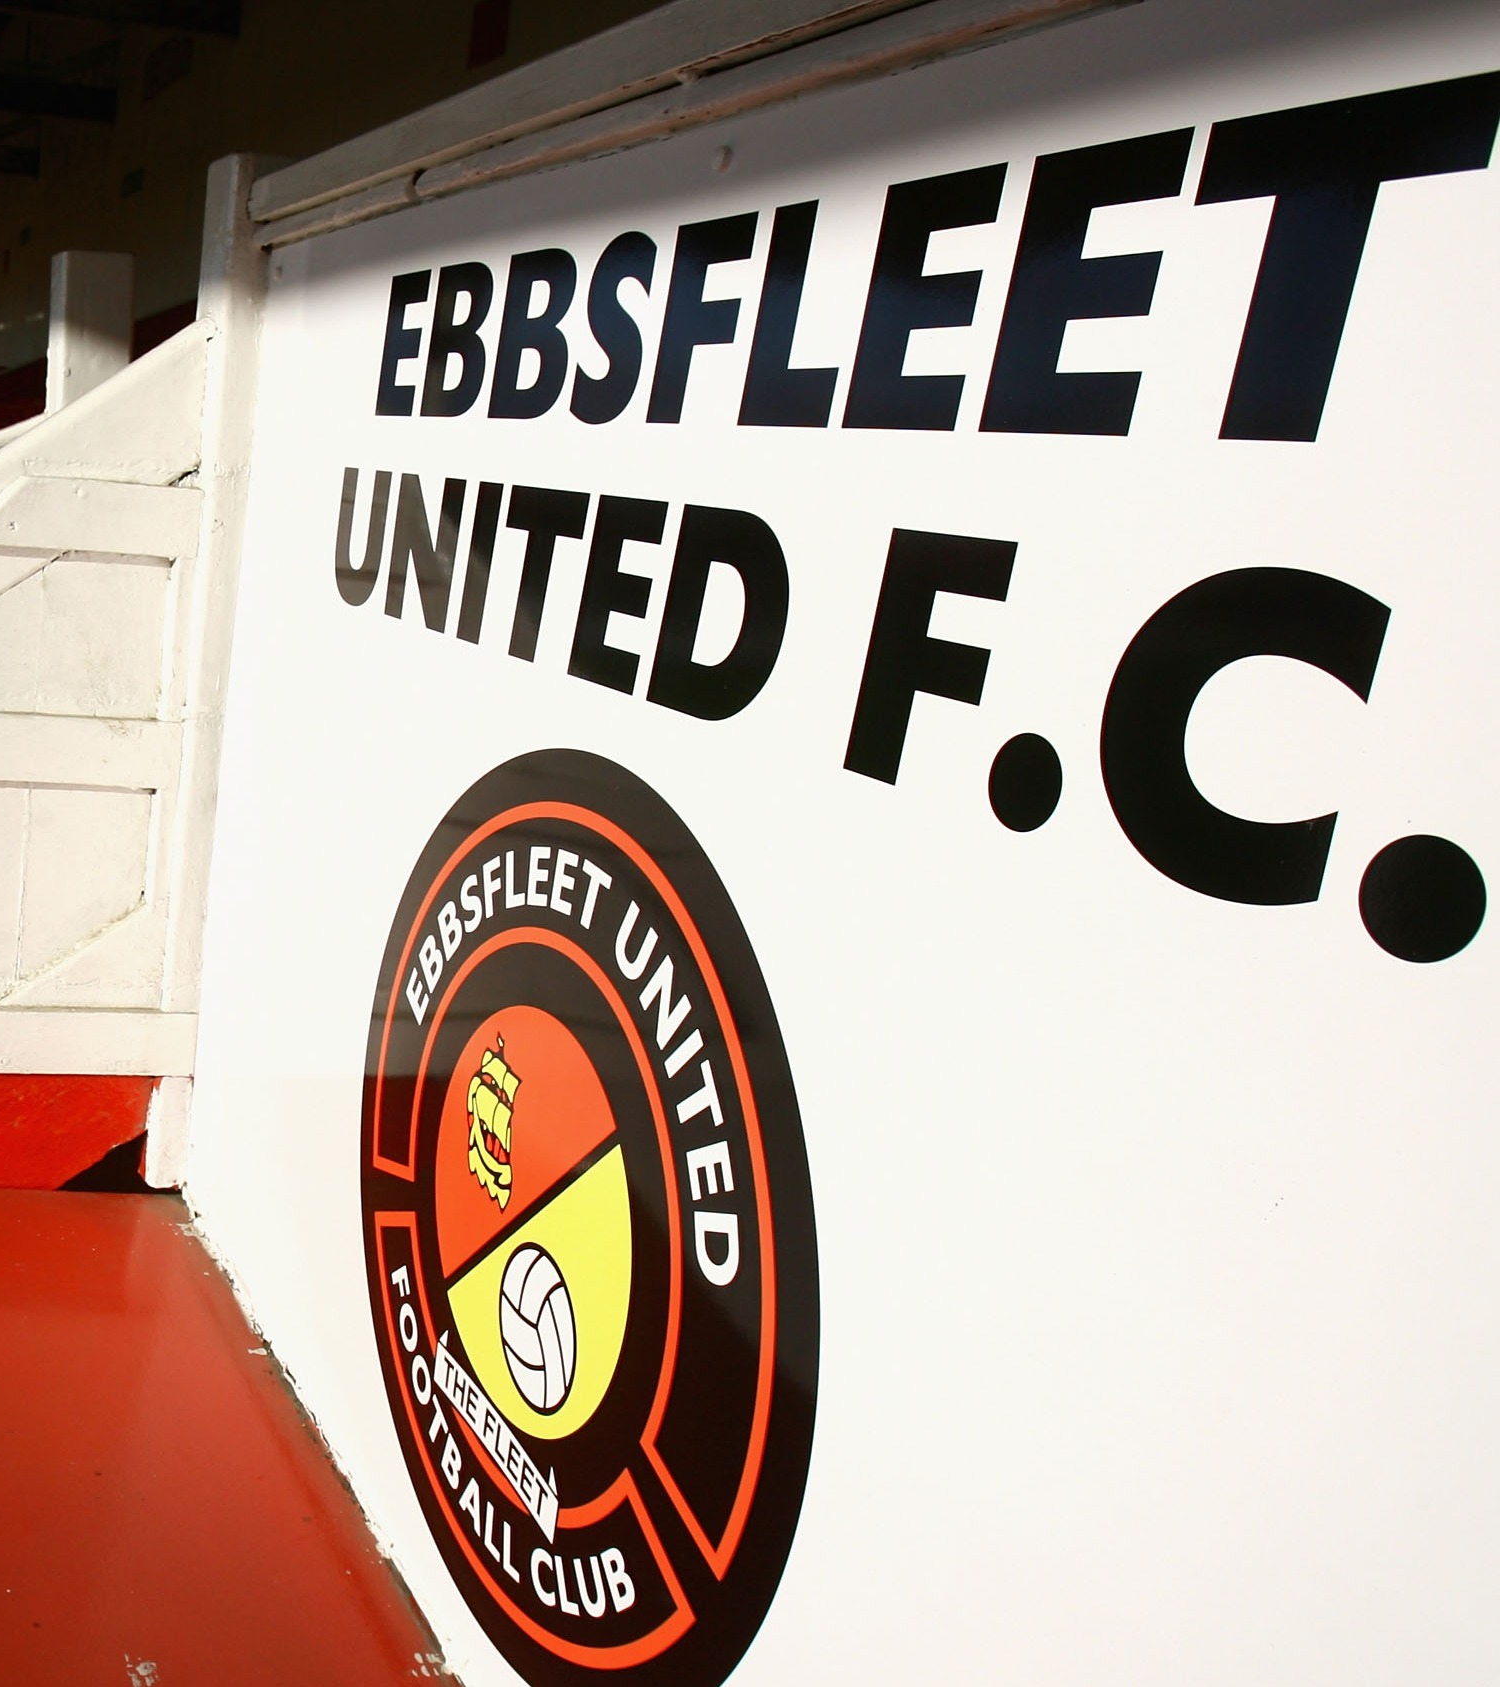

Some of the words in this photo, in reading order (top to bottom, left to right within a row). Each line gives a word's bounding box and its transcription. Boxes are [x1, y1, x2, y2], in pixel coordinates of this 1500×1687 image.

[375, 69, 1500, 442] EBBSFLEET
[334, 466, 790, 721] UNITED
[842, 527, 1487, 964] F.C.
[405, 845, 613, 1027] EBBSFLEET
[612, 900, 742, 1288] UNITED
[390, 1264, 523, 1583] FOOTBALL
[529, 1546, 637, 1619] CLUB
[443, 1356, 479, 1424] THE
[482, 1407, 548, 1518] FLEET
